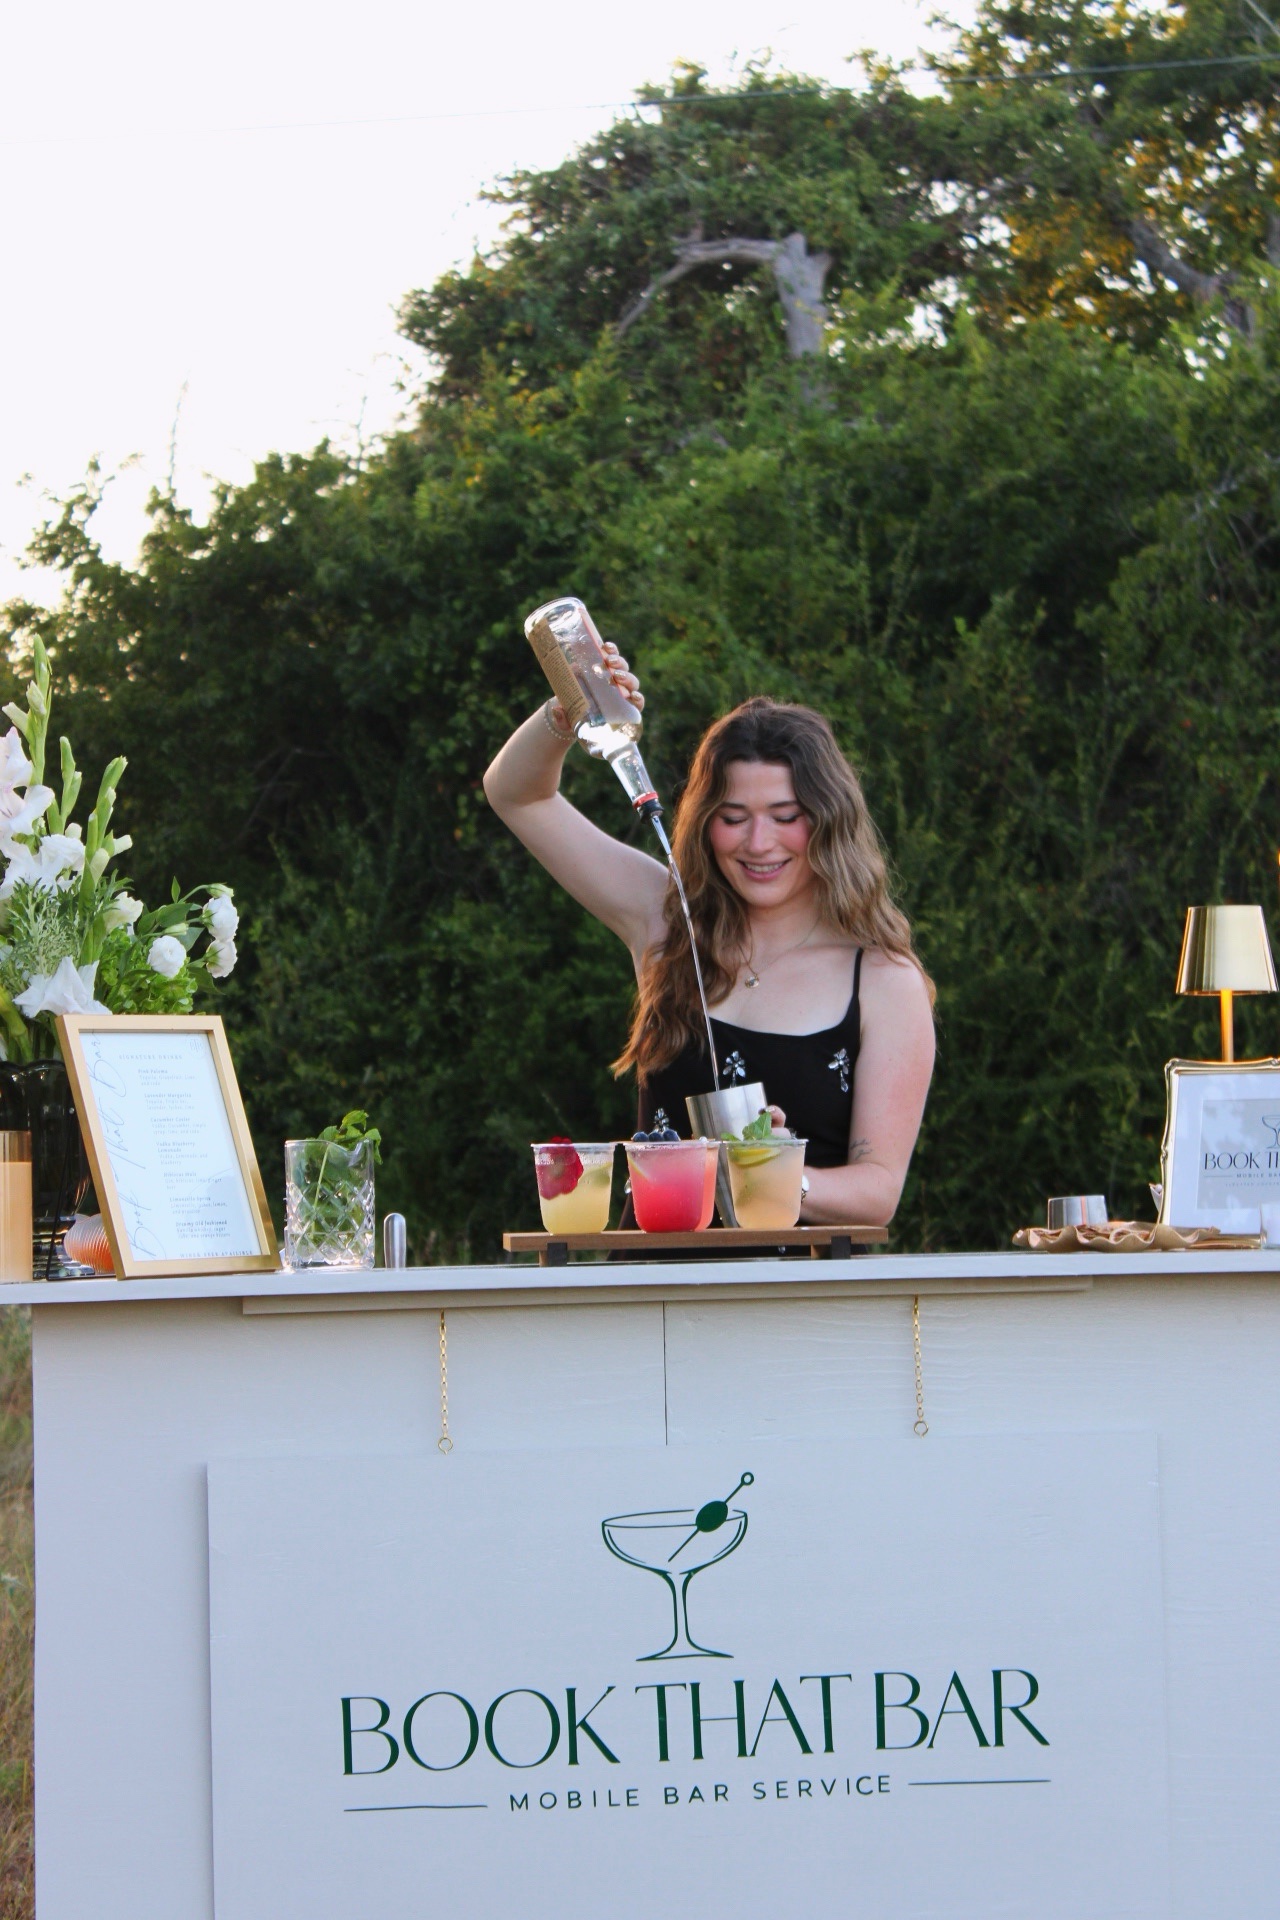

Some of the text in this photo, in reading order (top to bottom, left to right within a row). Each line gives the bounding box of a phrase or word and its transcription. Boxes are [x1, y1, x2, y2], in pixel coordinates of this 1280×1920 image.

[1204, 1151, 1260, 1170] BOOK
[340, 1669, 1051, 1776] BOOK THAT BAR
[509, 1775, 890, 1812] MOBILE BAR SERVICE
